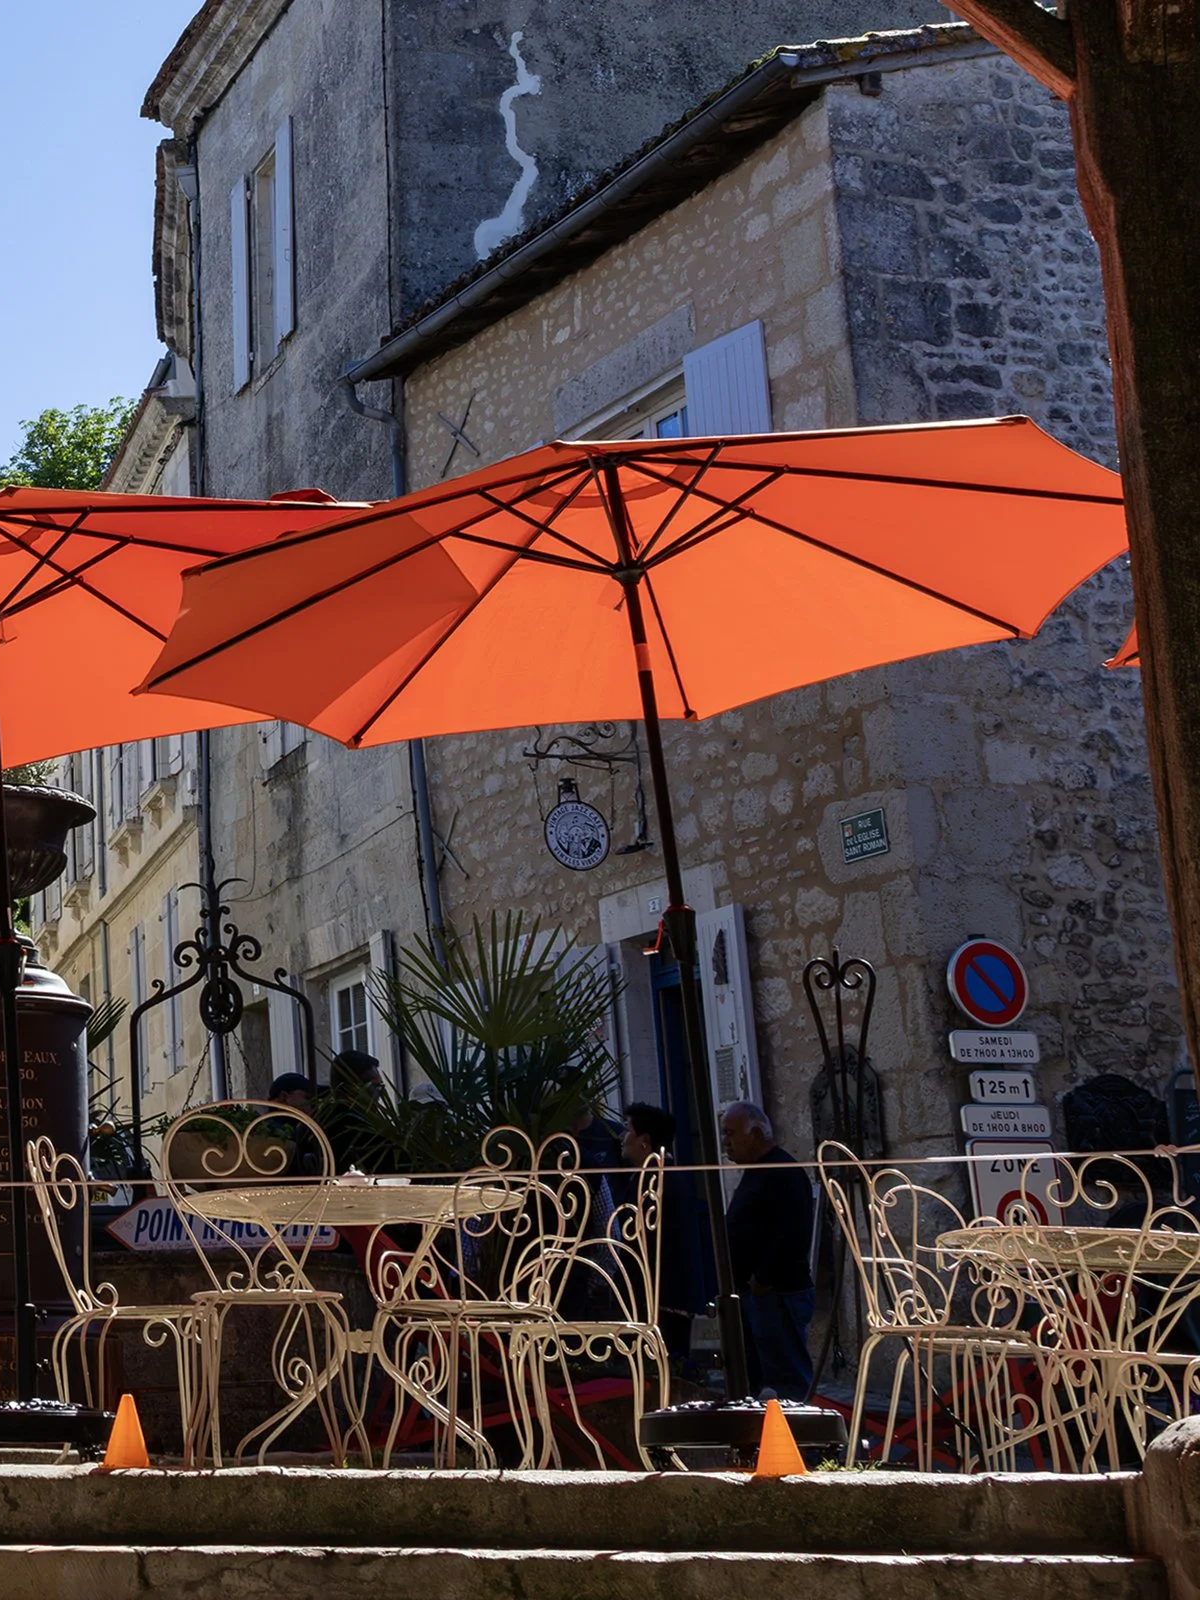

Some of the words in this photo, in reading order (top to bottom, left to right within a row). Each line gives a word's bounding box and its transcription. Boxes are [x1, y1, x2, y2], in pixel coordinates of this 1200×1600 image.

[550, 805, 570, 829] VINTAGE
[571, 805, 588, 814] JAZZ
[858, 817, 872, 829] RUE
[846, 837, 854, 847] DE
[845, 844, 862, 858] SAINT
[862, 839, 886, 852] ROMAIN
[978, 1036, 1013, 1046] SAMEDI
[960, 1048, 972, 1058] DE
[974, 1048, 998, 1059] 7H00
[1000, 1049, 1006, 1059] A
[1008, 1049, 1035, 1059] 13H00
[988, 1080, 1007, 1095] 25
[1009, 1085, 1020, 1095] m
[990, 1110, 1021, 1121] JEUDI
[972, 1122, 984, 1133] DE
[987, 1122, 1011, 1133] 1H00
[1013, 1122, 1020, 1133] A
[1022, 1123, 1046, 1133] 8H00
[990, 1158, 1041, 1173] ZONE
[134, 1208, 194, 1244] POINT
[202, 1218, 331, 1241] RENCTRE
